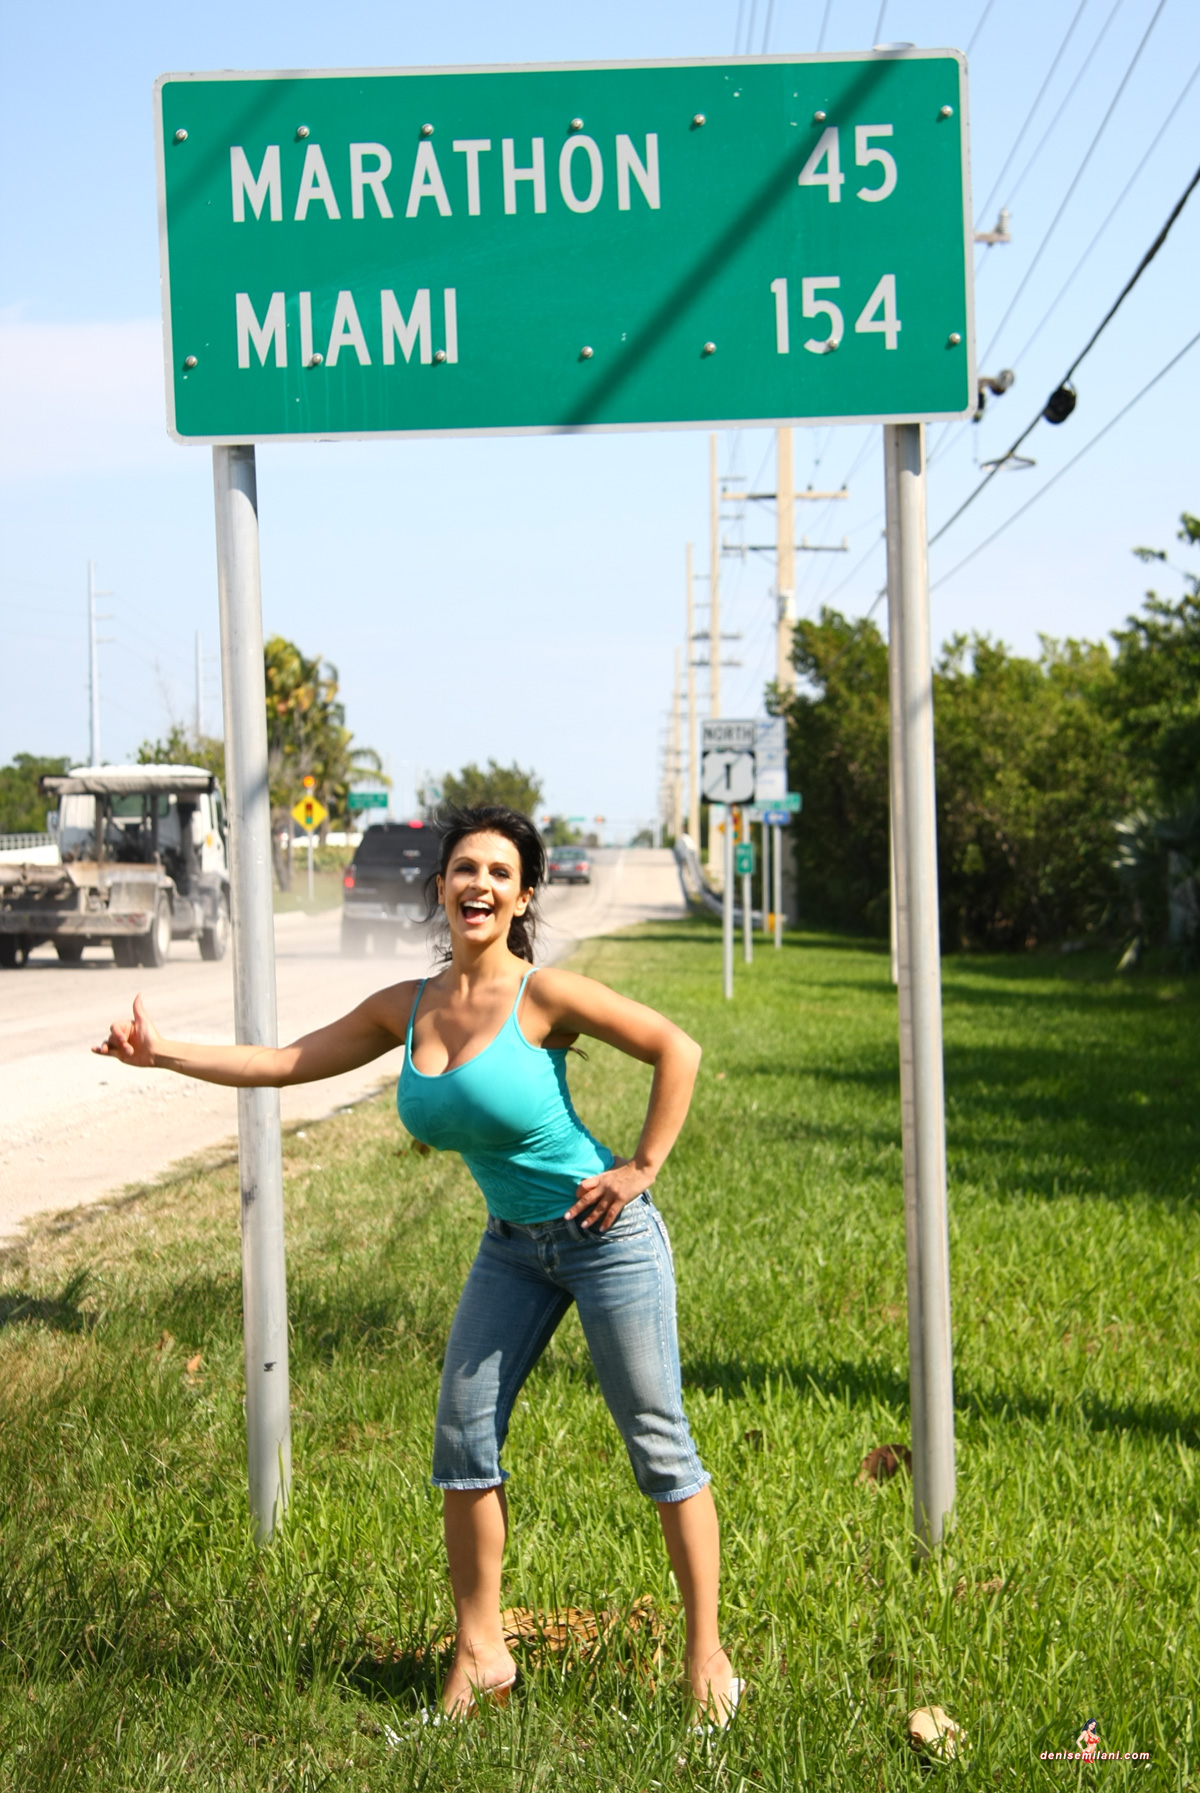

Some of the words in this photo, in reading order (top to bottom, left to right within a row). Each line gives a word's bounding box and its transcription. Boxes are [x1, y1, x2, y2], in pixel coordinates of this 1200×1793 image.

[230, 134, 661, 223] MARATHON
[798, 123, 898, 203] 45
[235, 287, 458, 369] MIAMI
[770, 274, 902, 354] 154
[703, 726, 753, 741] NORTH
[724, 762, 732, 790] 1
